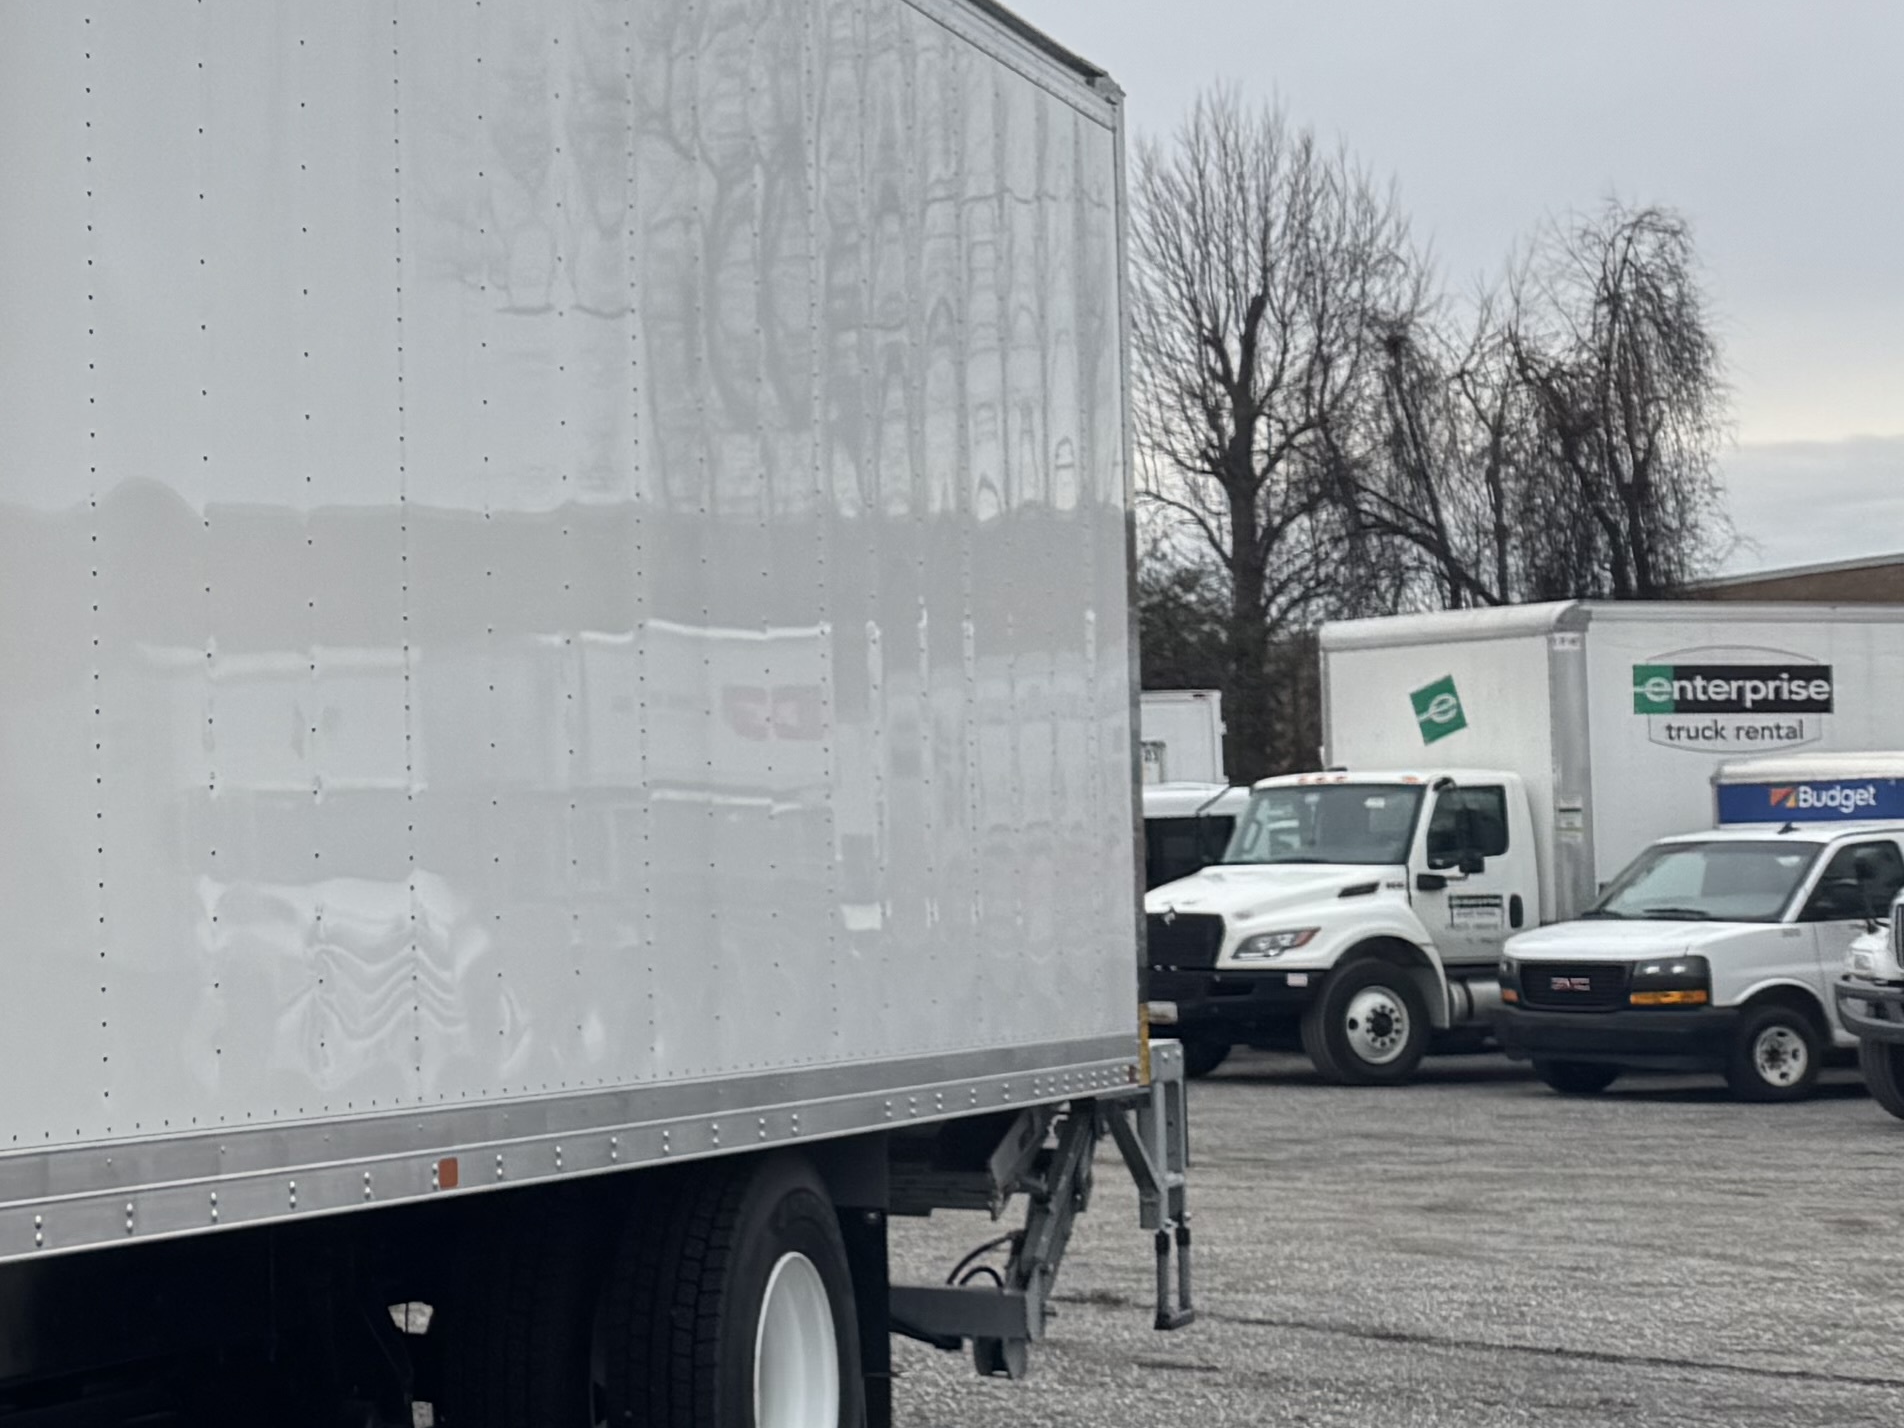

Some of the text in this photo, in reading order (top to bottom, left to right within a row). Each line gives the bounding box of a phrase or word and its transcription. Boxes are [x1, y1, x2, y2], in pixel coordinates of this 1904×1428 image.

[1643, 672, 1831, 709] enterprise
[1665, 719, 1804, 741] truck rental
[1798, 785, 1877, 813] Budget
